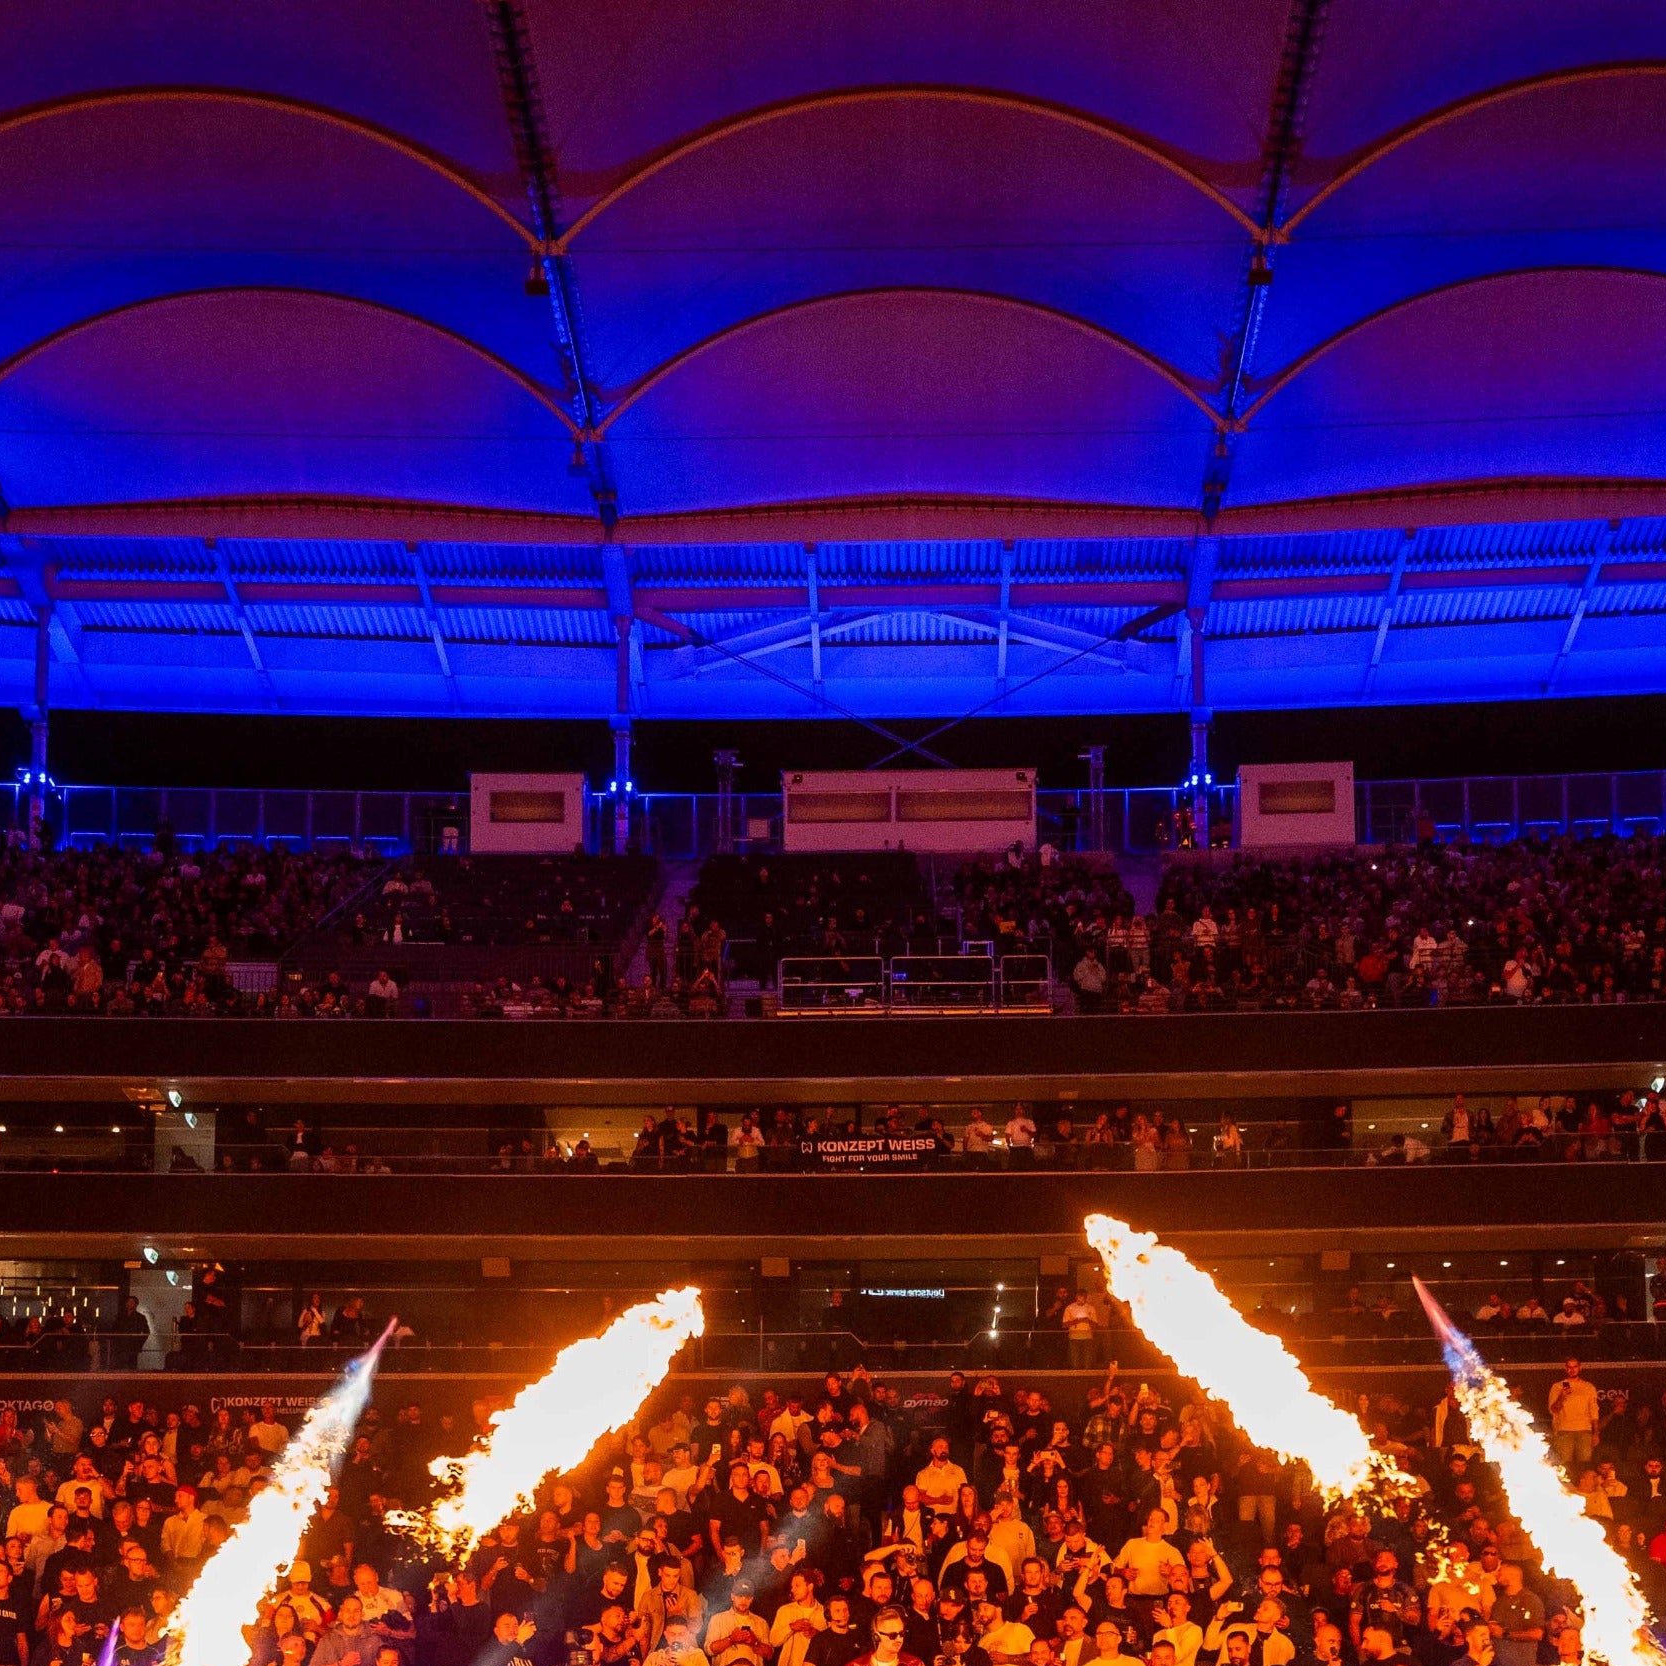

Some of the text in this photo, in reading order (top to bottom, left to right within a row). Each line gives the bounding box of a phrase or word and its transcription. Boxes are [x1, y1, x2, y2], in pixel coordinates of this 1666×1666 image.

[818, 1138, 935, 1152] KONZEPT WEISS
[848, 1154, 865, 1162] FOR
[867, 1154, 890, 1162] YOUR
[892, 1153, 918, 1161] SMILE
